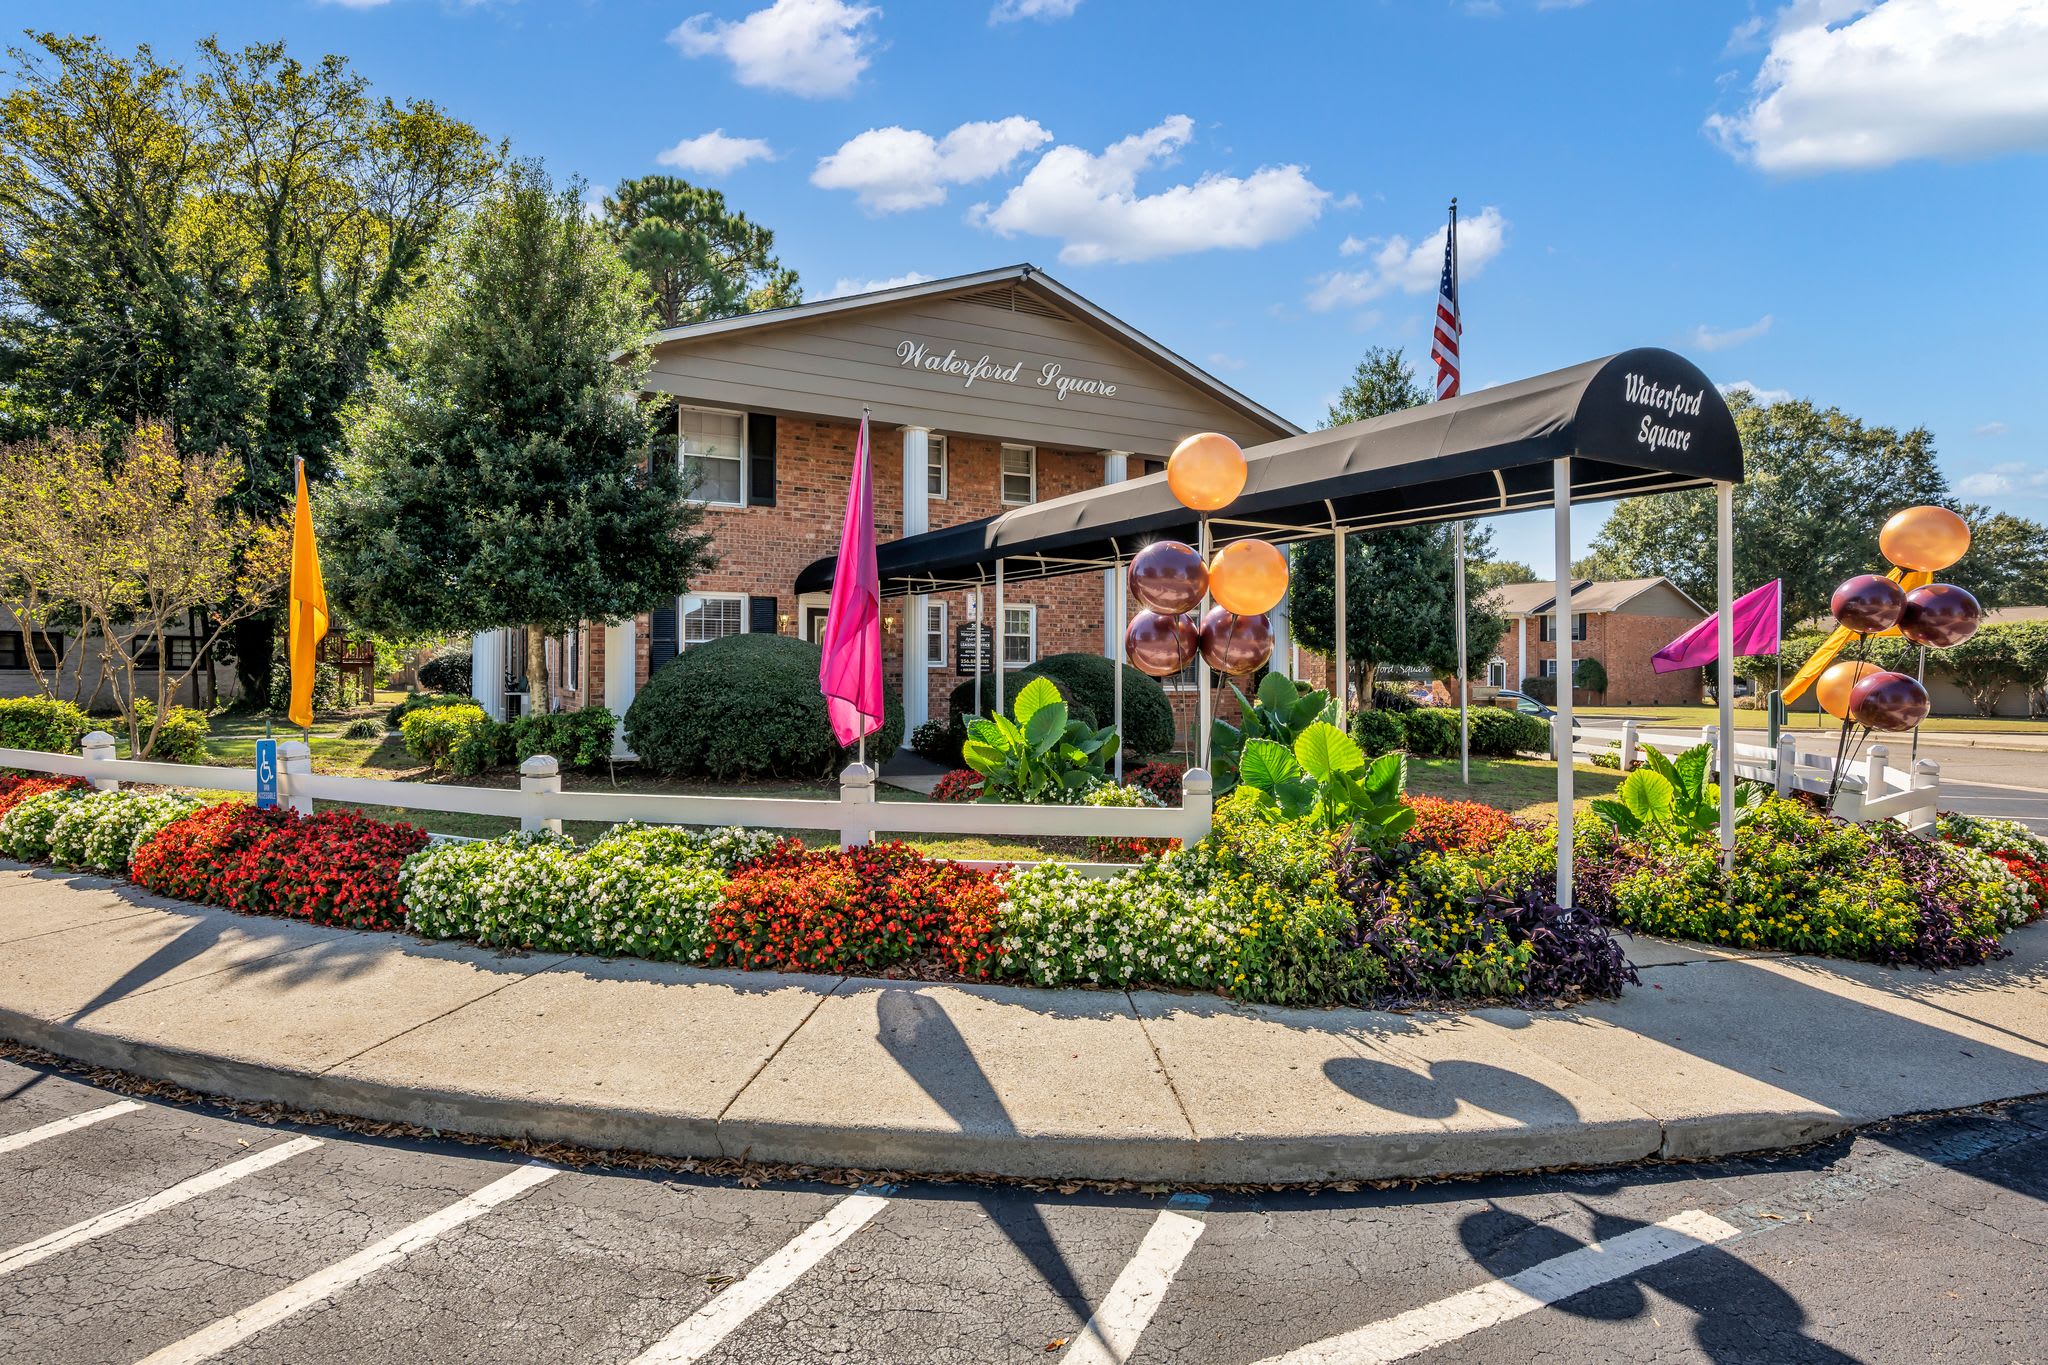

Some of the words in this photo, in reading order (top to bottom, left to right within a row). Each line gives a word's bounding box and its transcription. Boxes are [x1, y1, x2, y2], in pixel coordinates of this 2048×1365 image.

[896, 340, 1023, 387] Waterford
[1036, 362, 1118, 401] Square
[1625, 372, 1704, 418] Waterford
[1637, 414, 1691, 452] Square
